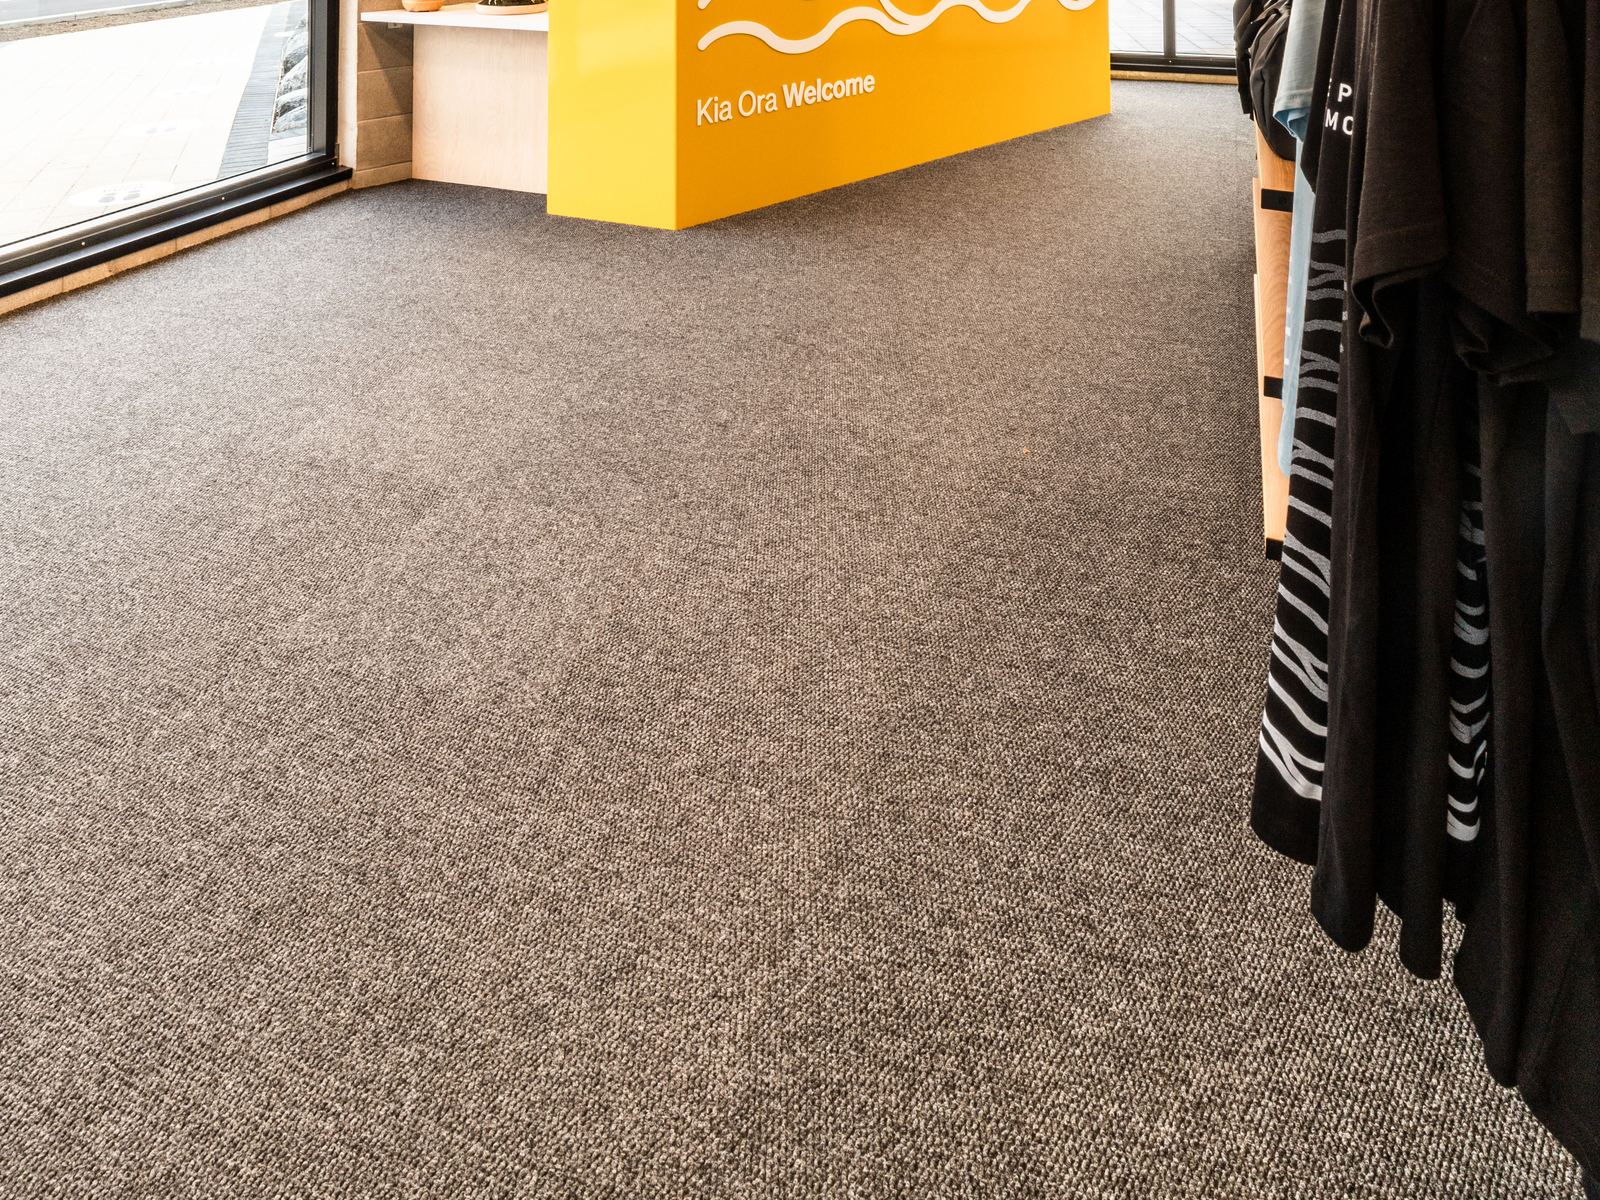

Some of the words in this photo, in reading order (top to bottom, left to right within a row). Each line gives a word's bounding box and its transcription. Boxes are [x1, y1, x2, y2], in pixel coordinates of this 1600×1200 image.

[697, 97, 732, 126] Kia
[738, 90, 778, 117] Ora
[782, 74, 876, 109] Welcome
